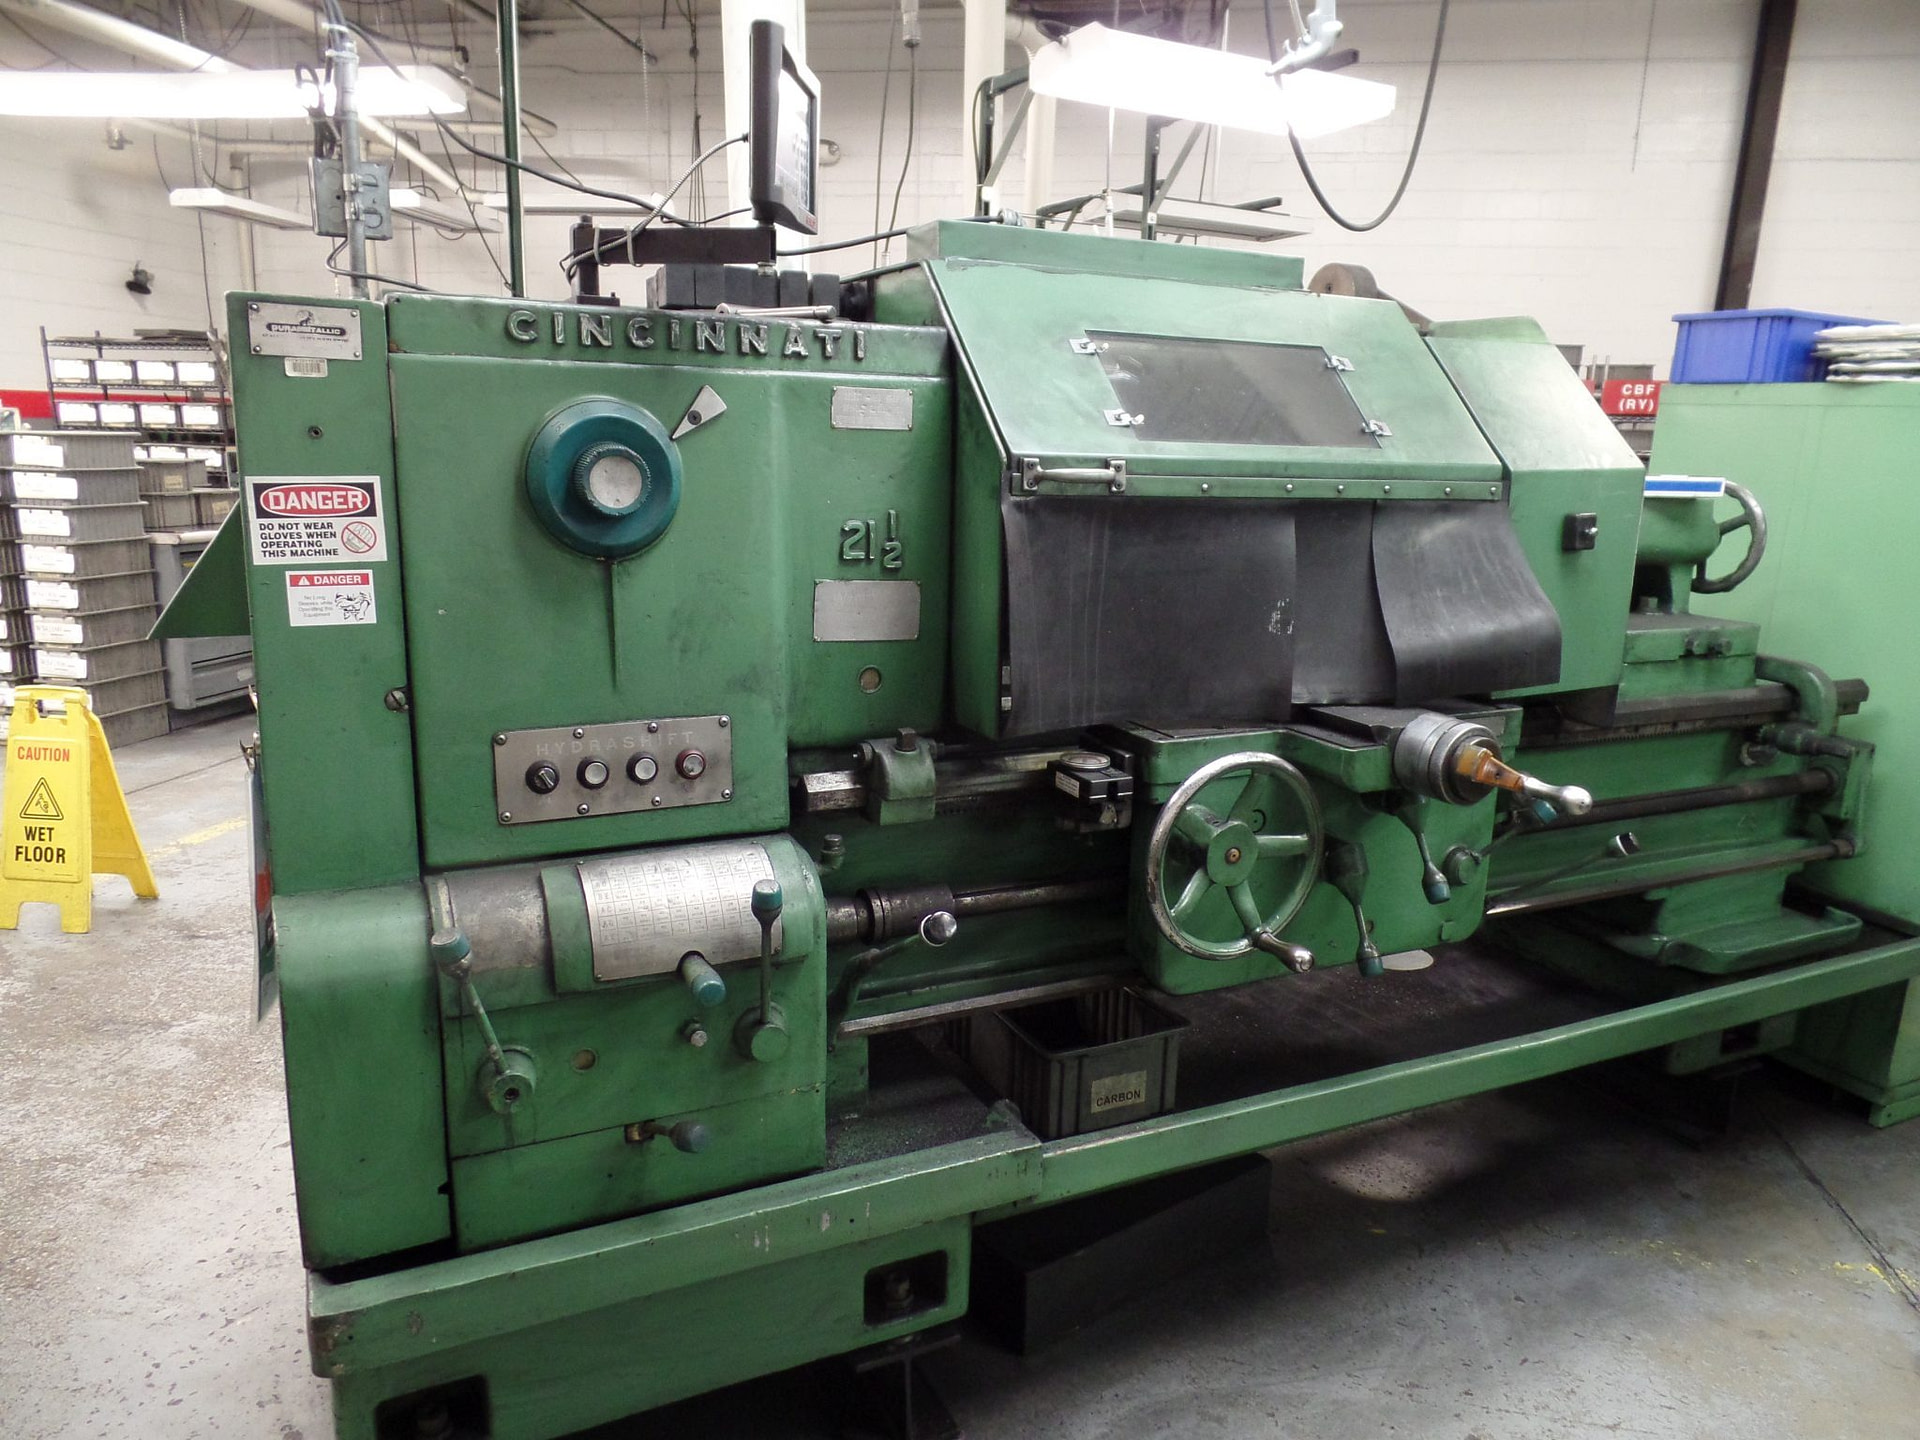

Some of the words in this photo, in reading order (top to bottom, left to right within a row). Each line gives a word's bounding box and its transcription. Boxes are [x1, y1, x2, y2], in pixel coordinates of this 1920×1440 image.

[507, 310, 866, 360] CINCINNATI
[1622, 384, 1655, 395] CBF
[1619, 398, 1654, 412] (RY)
[268, 491, 363, 510] DANGER
[259, 523, 274, 531] DO
[278, 522, 299, 531] NOT
[303, 522, 333, 530] WEAR
[260, 532, 303, 540] GLOVES
[306, 531, 337, 539] WHEN
[261, 540, 323, 549] OPERATING
[262, 550, 286, 558] THIS
[290, 548, 339, 557] MACHINE
[314, 575, 362, 585] DANGER
[537, 731, 693, 756] HYDRASHIFT
[17, 746, 70, 762] CAUTION
[24, 826, 55, 842] WET
[15, 845, 66, 864] FLOOR
[1096, 1089, 1141, 1107] CARBON
